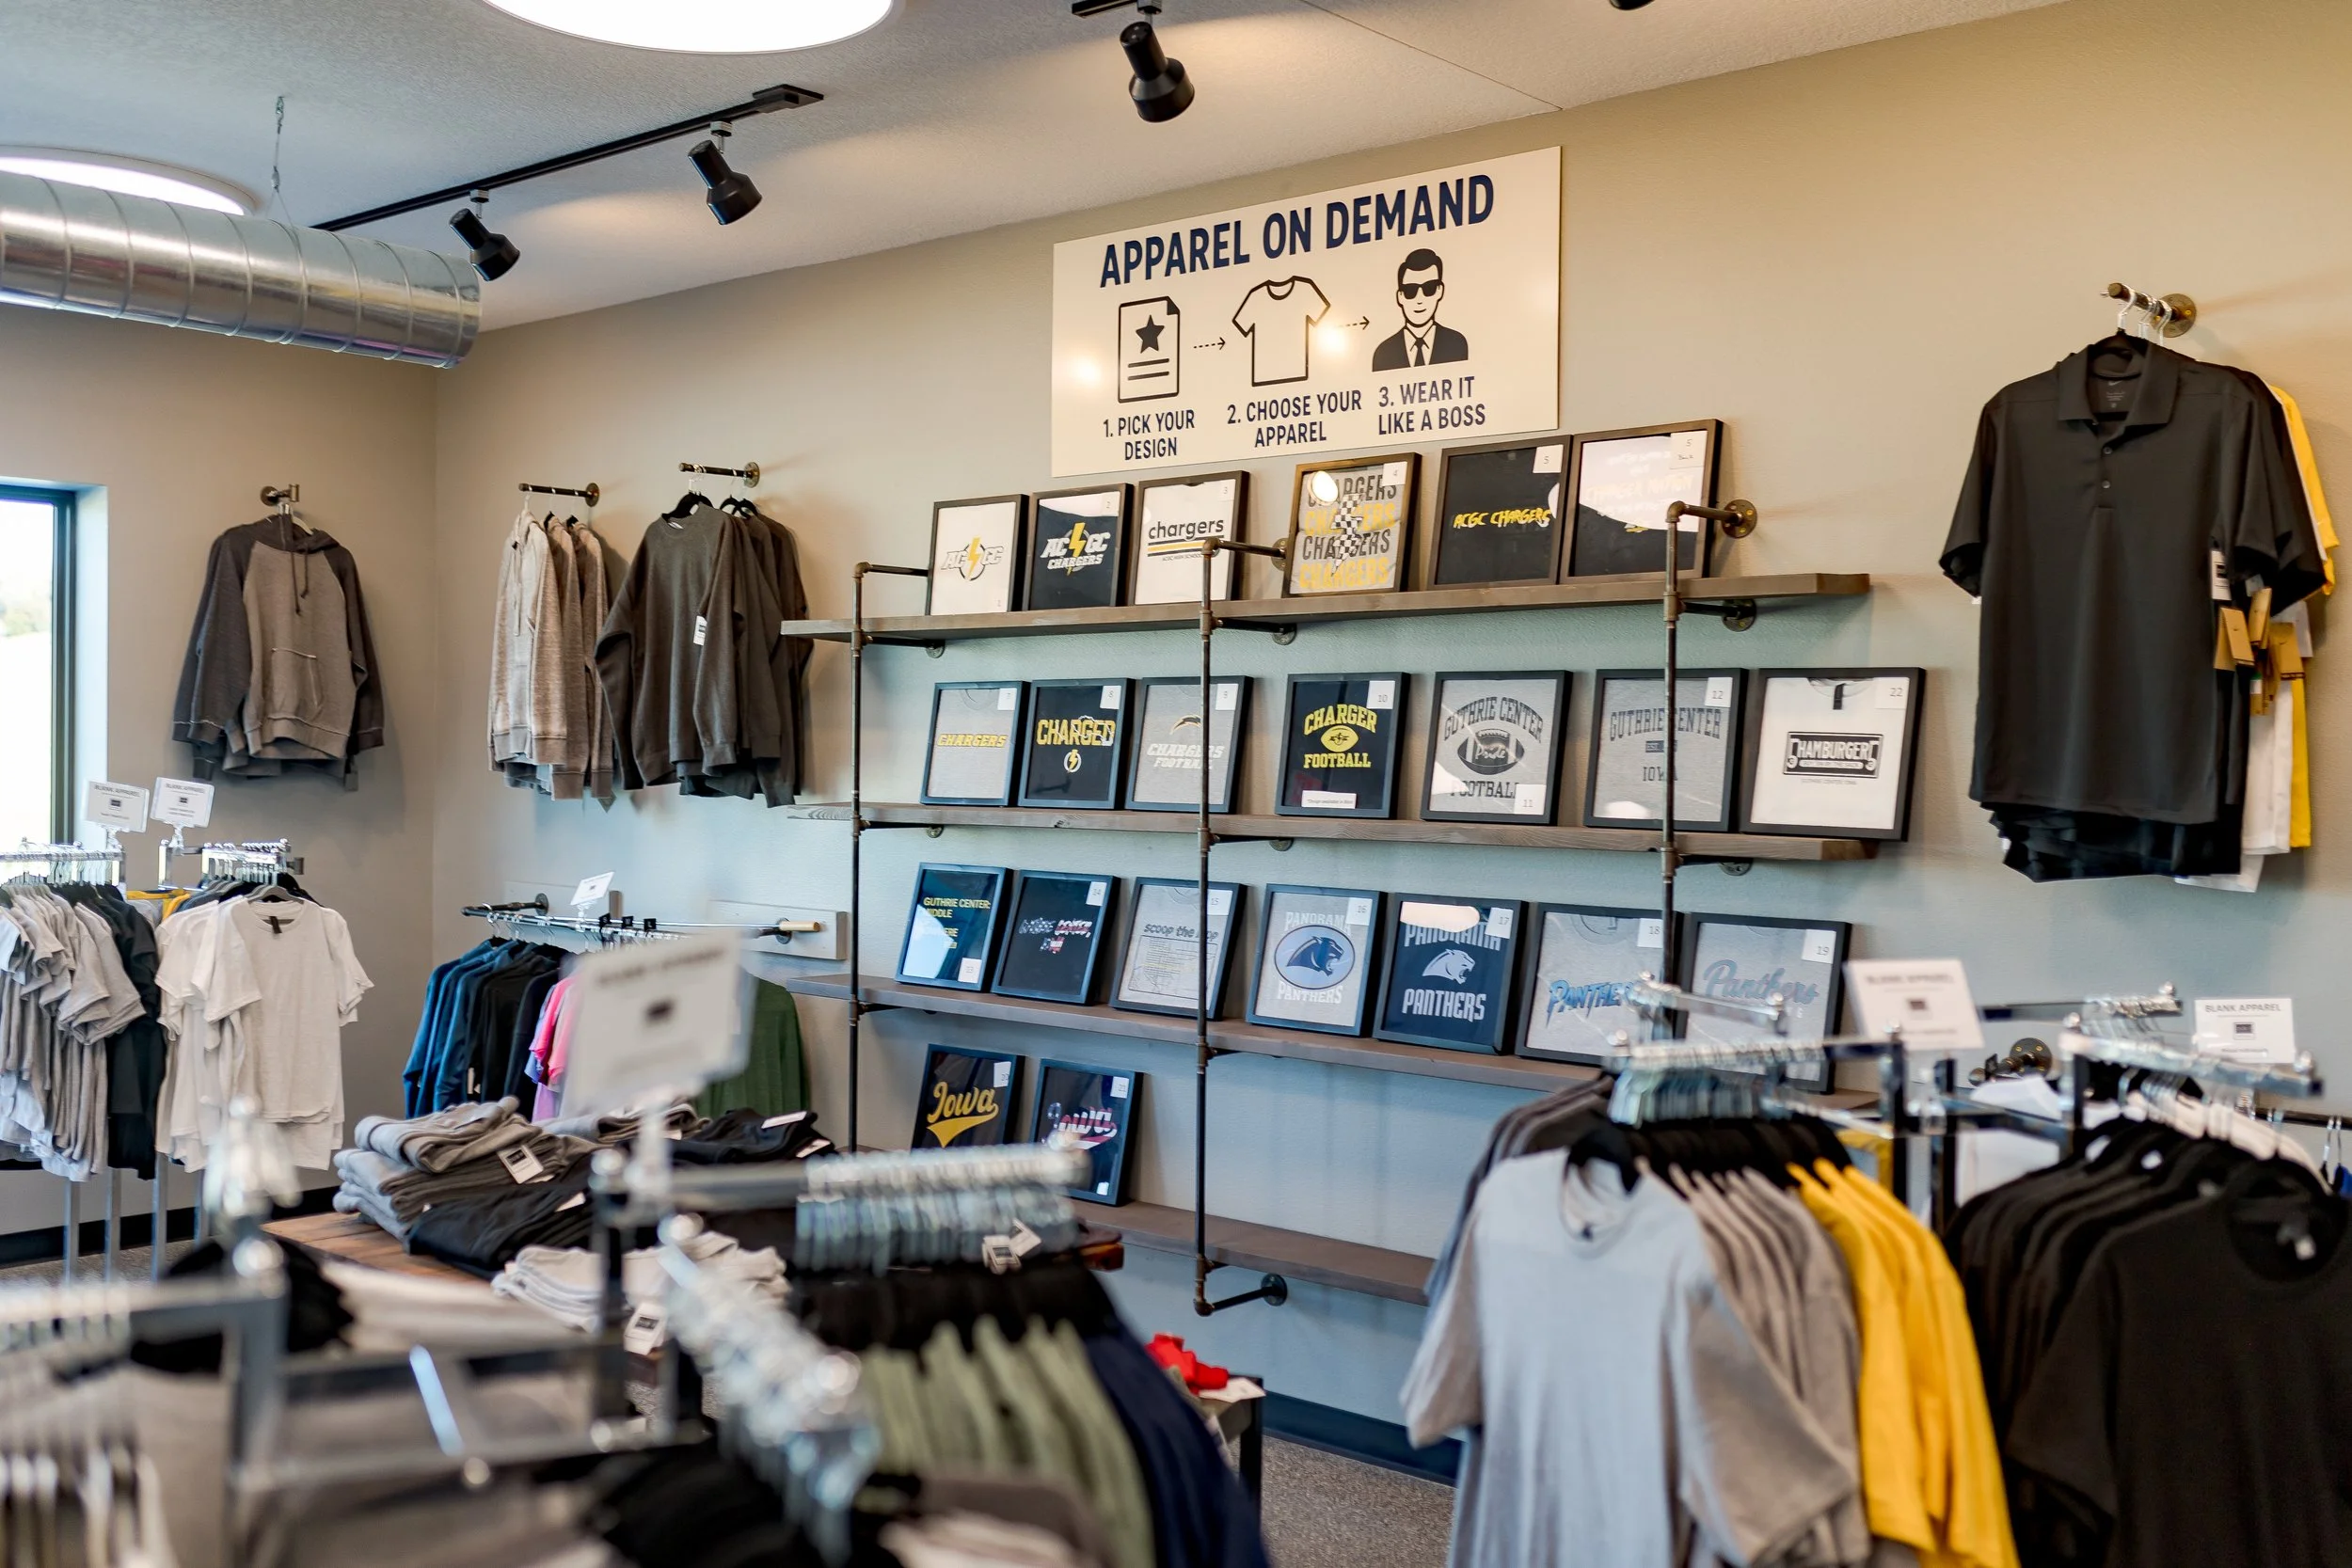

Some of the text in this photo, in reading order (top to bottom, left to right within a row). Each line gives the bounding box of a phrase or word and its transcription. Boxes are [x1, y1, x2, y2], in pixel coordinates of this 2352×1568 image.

[1100, 174, 1494, 288] APPAREL ON DEMAND
[1378, 376, 1474, 407] 3. WEAR IT
[1227, 389, 1361, 424] 2. CHOOSE YOUR
[1103, 409, 1195, 437] 1. PICK YOUR
[1378, 404, 1486, 436] LIKE A BOSS
[1254, 421, 1327, 448] APPAREL
[1124, 436, 1177, 461] DESIGN
[1543, 456, 1549, 465] 5
[1149, 519, 1224, 540] chargers
[1453, 507, 1551, 529] ACGC CHARGERS
[1302, 529, 1391, 560] CHAGERS
[1047, 554, 1104, 570] CHARGERS
[1377, 694, 1389, 703] 10
[1712, 690, 1724, 699] 12
[1889, 688, 1903, 697] 22
[1304, 704, 1377, 736] CHARGER
[1444, 696, 1544, 743] GUTHRIE CENTER
[1610, 707, 1721, 741] GUTHRIE ENTER
[937, 734, 1009, 748] CHARGERS
[1036, 719, 1116, 747] CHARGED
[1303, 752, 1372, 768] FOOTBALL
[1798, 740, 1869, 760] HAMBURGER
[1522, 800, 1534, 808] 11
[923, 897, 959, 907] GUTHRIE
[1144, 923, 1174, 937] scoop
[1176, 926, 1195, 938] the
[1816, 945, 1830, 957] 19
[1279, 980, 1343, 1004] PANTHERS
[1546, 979, 1634, 1029] PANTHE
[1402, 988, 1486, 1022] PANTHERS
[2204, 1003, 2281, 1013] BLANK APPAREL
[927, 1082, 999, 1123] Iowa
